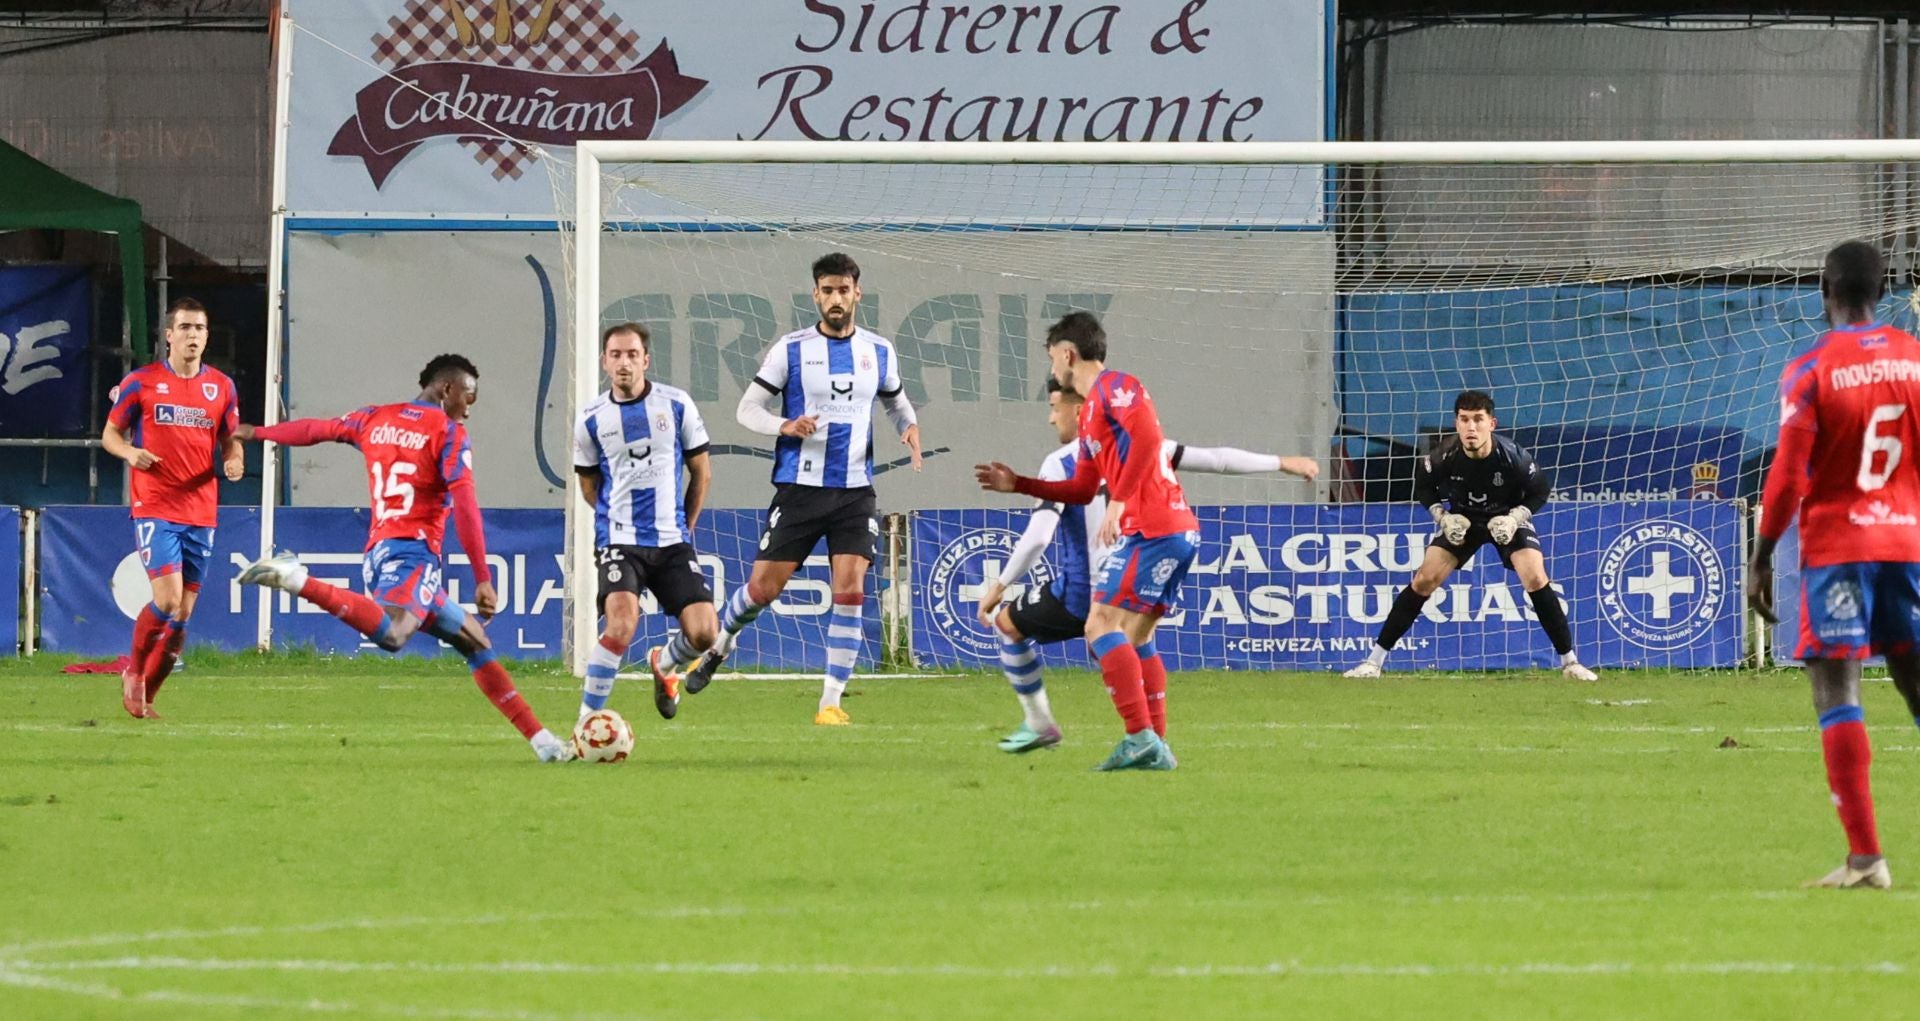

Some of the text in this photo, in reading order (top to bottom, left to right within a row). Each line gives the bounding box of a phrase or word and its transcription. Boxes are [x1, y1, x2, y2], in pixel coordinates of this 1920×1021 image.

[1150, 0, 1210, 54] &
[384, 73, 635, 134] Cabruñana
[737, 64, 1264, 142] Restaurante
[175, 406, 206, 417] Grupo
[1857, 404, 1906, 491] 6
[371, 461, 417, 527] 15
[137, 521, 155, 547] 17
[1280, 532, 1475, 574] CRU
[932, 533, 997, 629] LA CRUZ DE
[1602, 525, 1720, 621] LA CRUZ DE ASTURIAS
[1630, 627, 1693, 641] CERVEZA NATURAL
